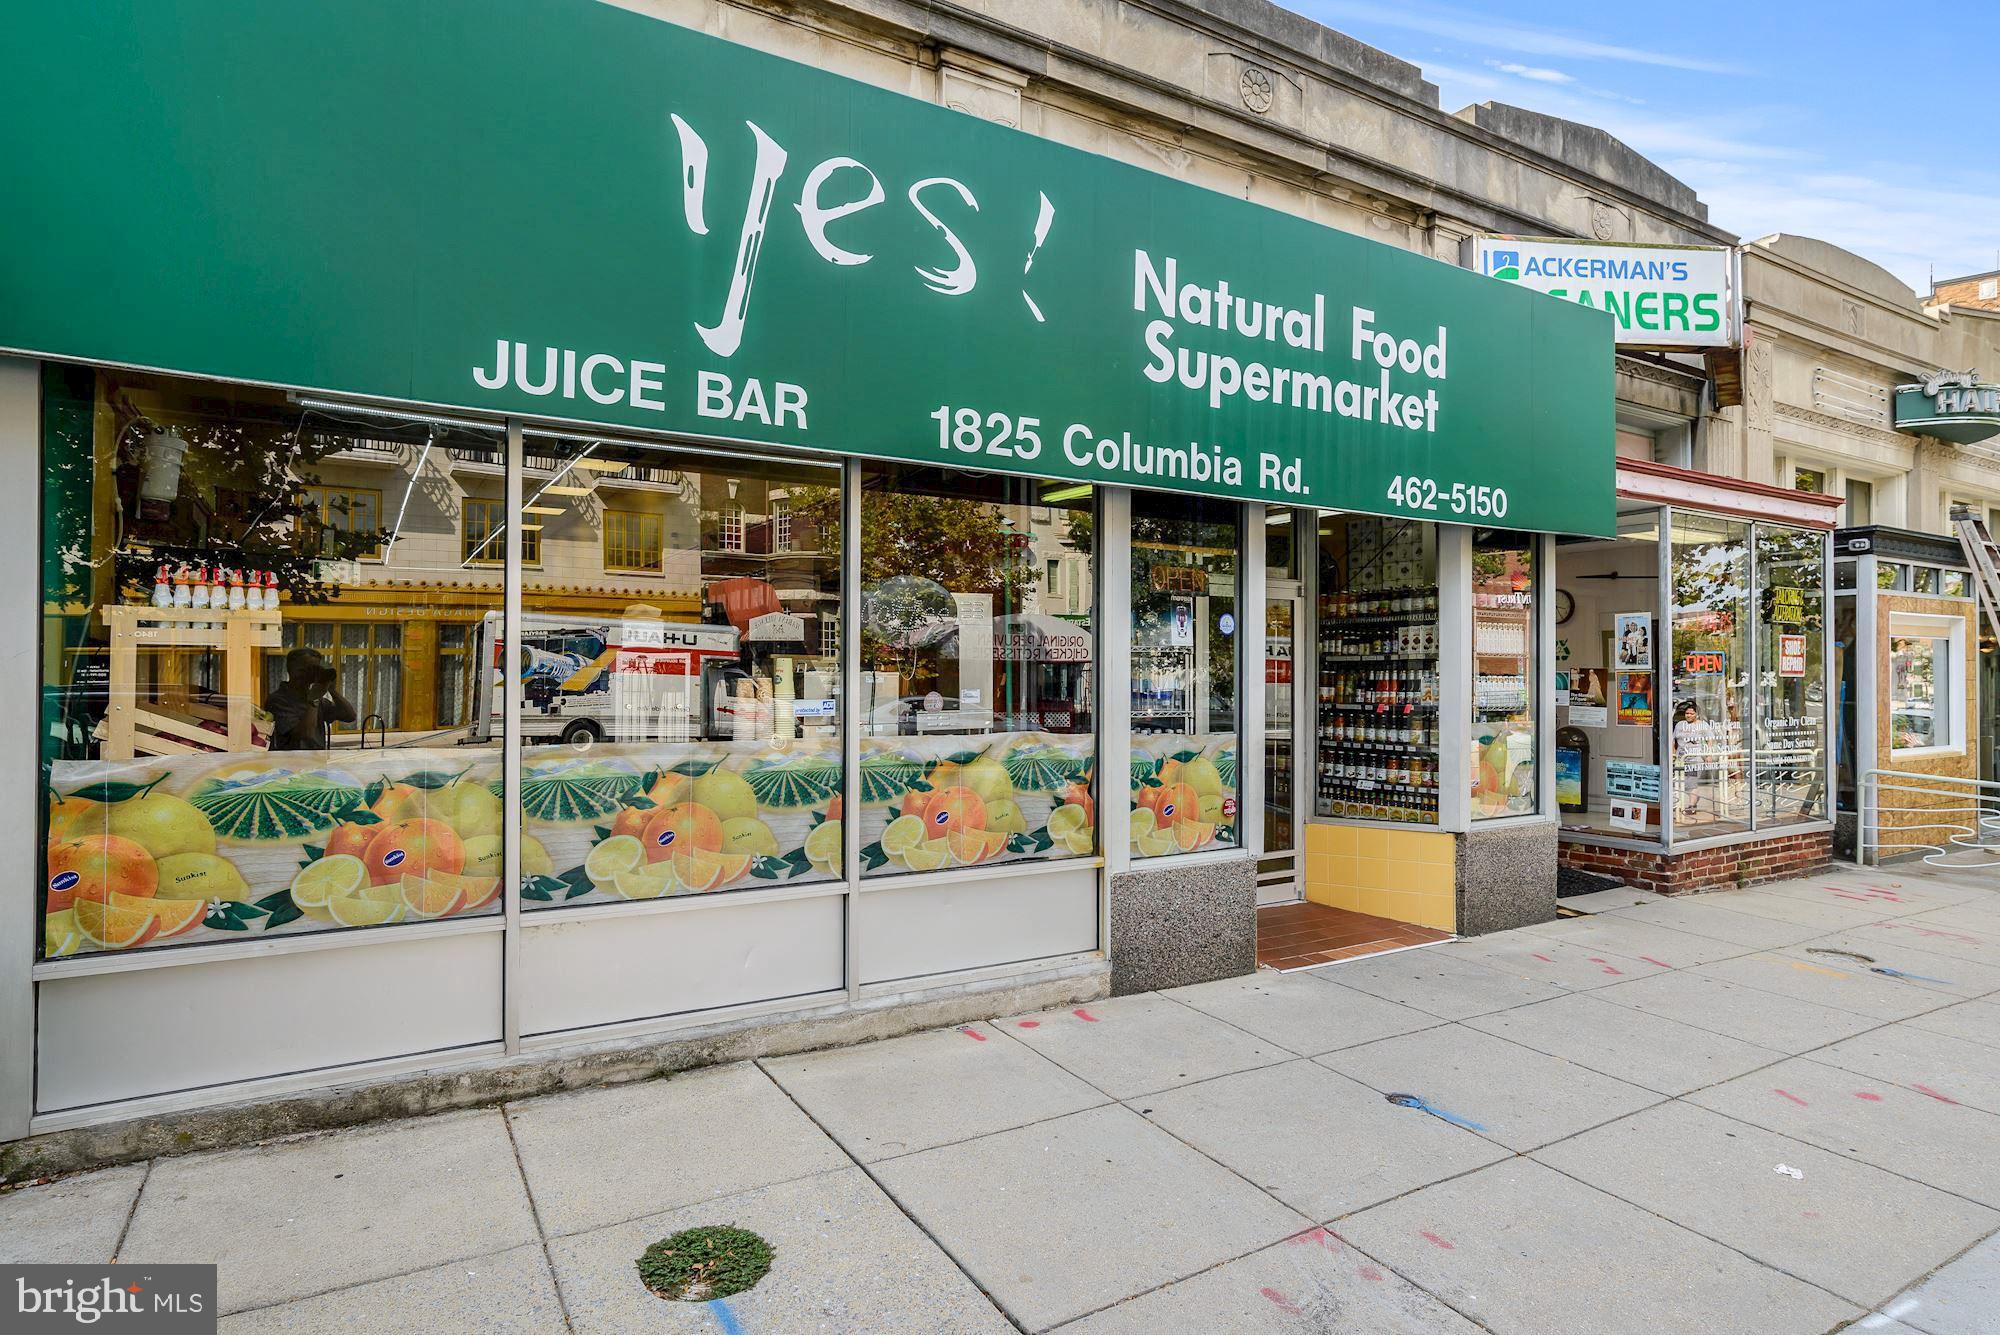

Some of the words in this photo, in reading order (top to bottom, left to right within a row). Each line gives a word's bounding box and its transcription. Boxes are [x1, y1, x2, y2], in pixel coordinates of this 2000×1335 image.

[1524, 256, 1688, 281] ACKERMAN'S
[1135, 249, 1324, 351] Natural
[1352, 306, 1447, 380] Food
[473, 339, 666, 412] JUICE
[697, 370, 808, 429] BAR
[1144, 320, 1439, 432] Supermarket
[931, 405, 1042, 460] 1825
[1063, 424, 1242, 485] Columbia
[1260, 452, 1310, 494] Rd.
[1387, 475, 1508, 518] 462-5150
[1152, 566, 1206, 592] OPEN
[1785, 640, 1801, 655] SHOE
[1686, 655, 1722, 673] OPEN
[1782, 656, 1803, 672] REPAIR
[1682, 720, 1709, 733] Organic
[1764, 717, 1788, 730] Organic
[1789, 717, 1799, 728] Dry
[1800, 716, 1816, 726] Clean
[1767, 740, 1782, 749] Same
[1783, 739, 1795, 750] Day
[1795, 737, 1815, 748] Service
[1684, 763, 1704, 772] EXPERT
[477, 850, 503, 863] Sunkist
[52, 874, 78, 889] Sunkist
[174, 870, 207, 884] Sunkist
